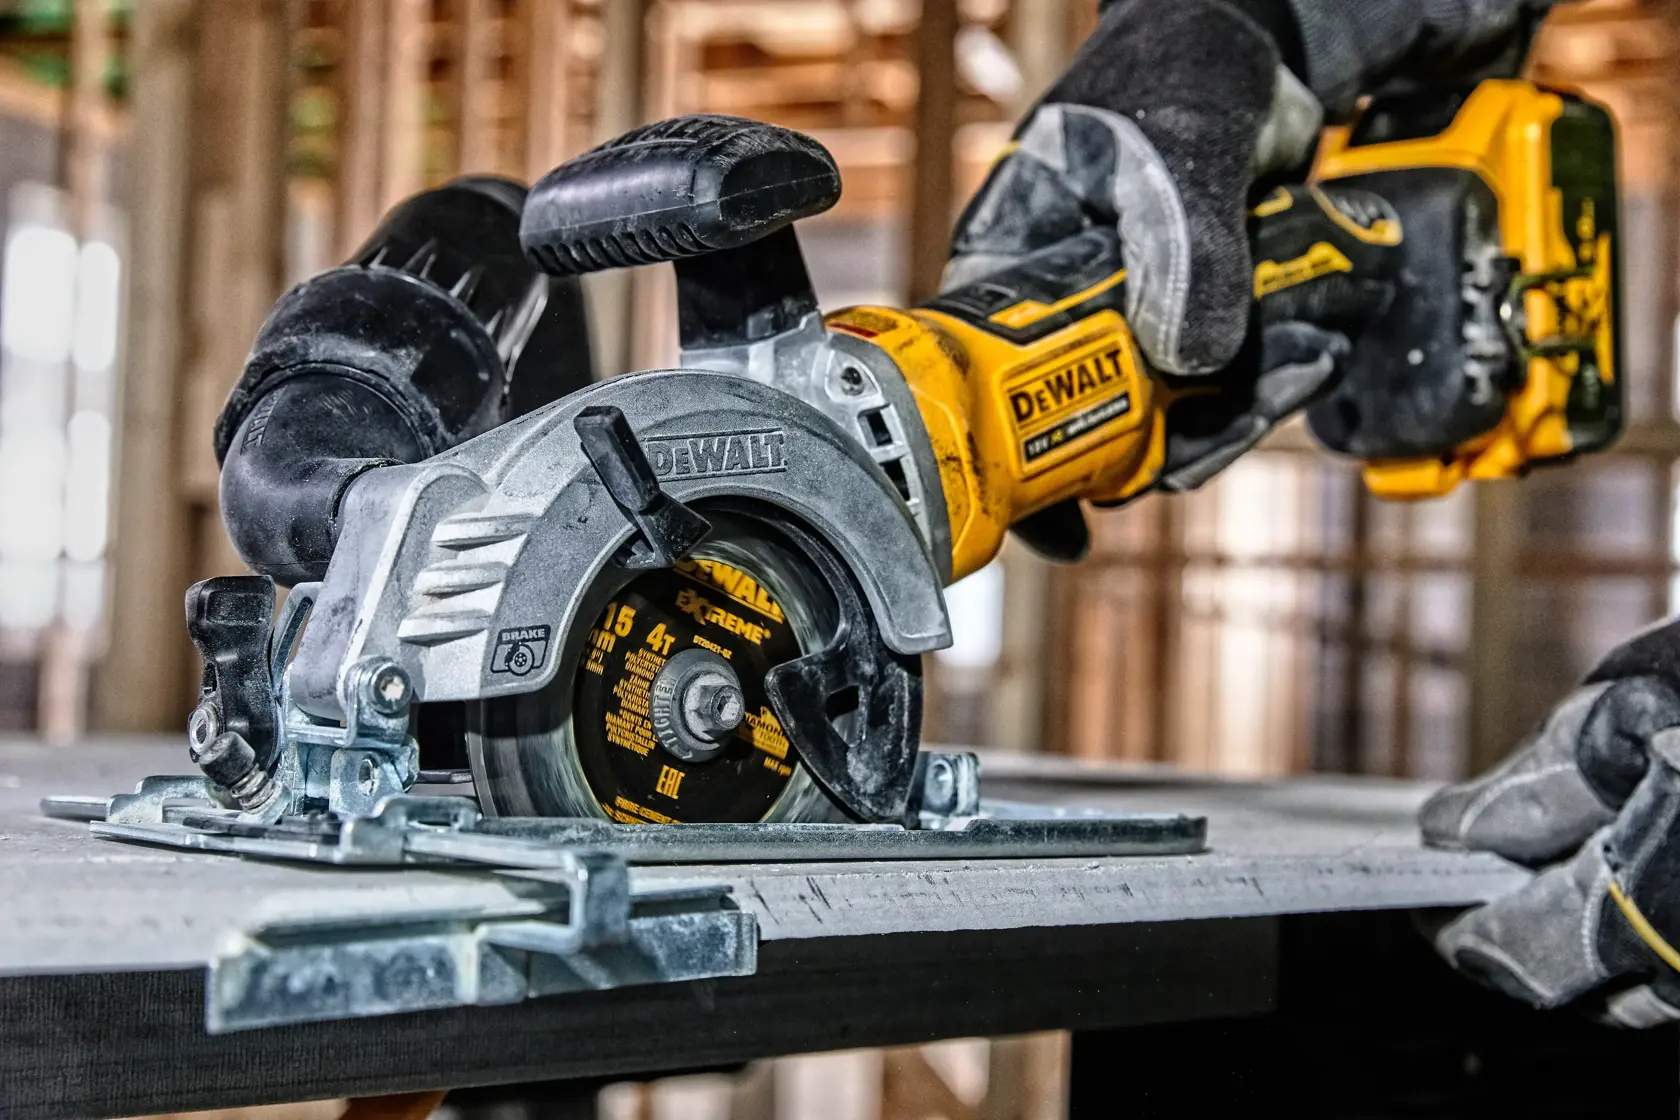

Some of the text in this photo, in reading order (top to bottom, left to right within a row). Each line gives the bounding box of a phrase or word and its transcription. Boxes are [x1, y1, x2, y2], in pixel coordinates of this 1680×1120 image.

[1010, 349, 1122, 422] DEWALT
[647, 432, 785, 476] DEWALT
[502, 628, 546, 641] BRAKE
[646, 623, 677, 656] 4T
